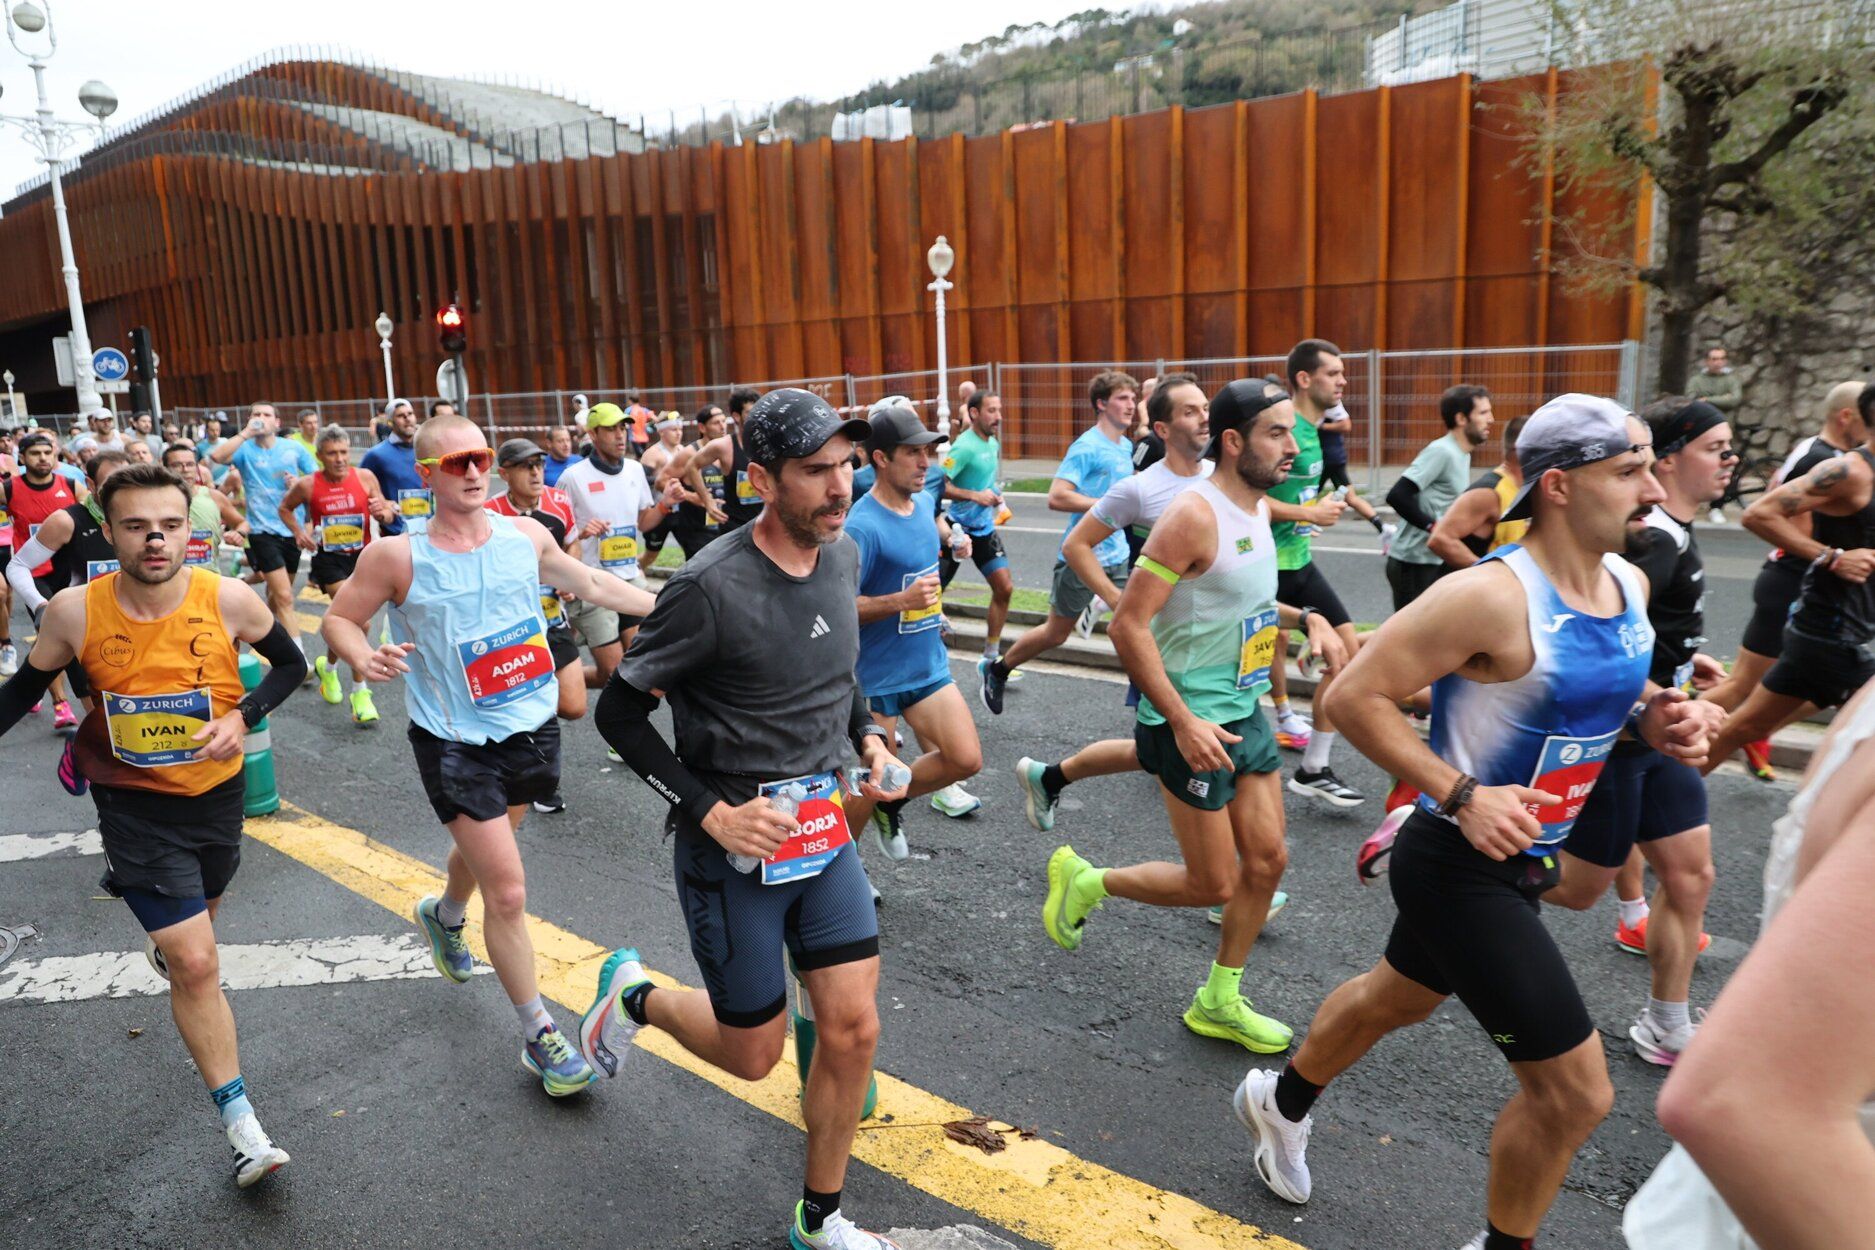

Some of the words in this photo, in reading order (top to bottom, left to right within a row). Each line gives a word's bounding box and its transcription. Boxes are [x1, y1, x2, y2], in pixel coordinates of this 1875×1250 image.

[1581, 442, 1606, 461] 365
[612, 543, 632, 551] OMAR
[491, 625, 529, 648] ZURICH
[492, 651, 536, 678] ADAM
[504, 672, 527, 688] 1812
[142, 698, 193, 710] ZURICH
[141, 725, 187, 738] IVAN
[151, 740, 174, 751] 212
[646, 774, 682, 805] KIPRUN
[801, 837, 829, 855] 1852
